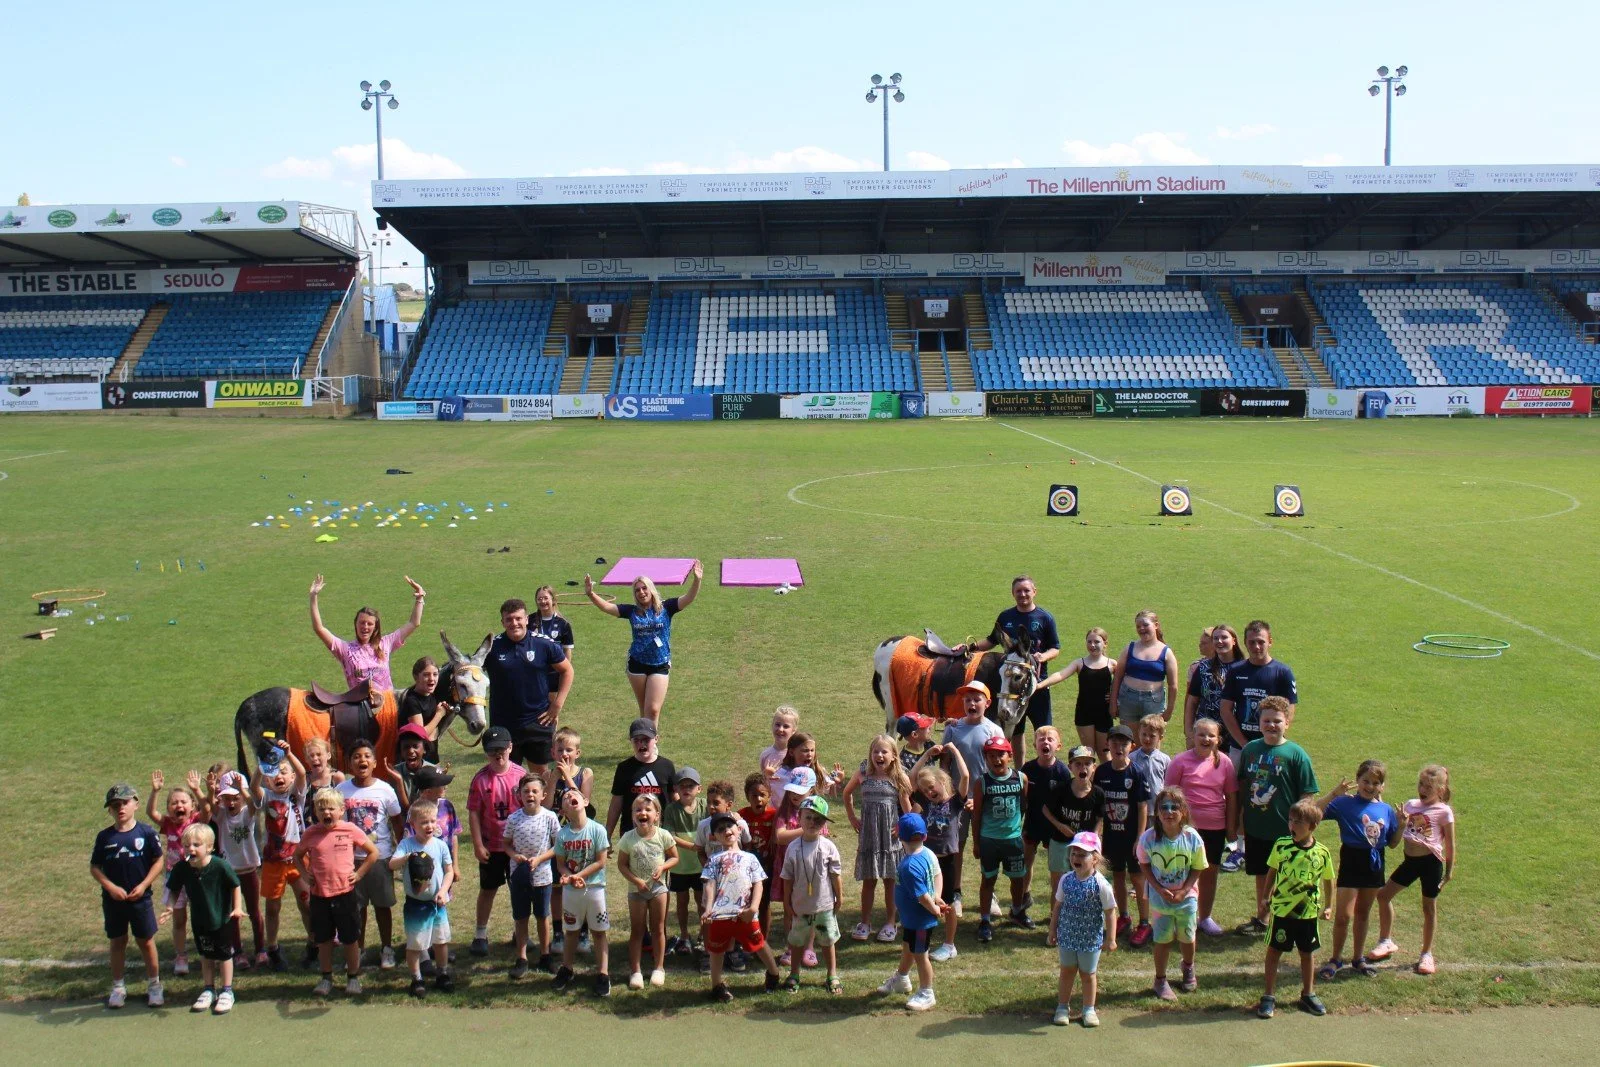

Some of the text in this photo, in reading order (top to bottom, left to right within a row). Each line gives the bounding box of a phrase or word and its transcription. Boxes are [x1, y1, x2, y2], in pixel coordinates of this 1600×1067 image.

[958, 178, 992, 194] Fulfilling
[1026, 176, 1225, 193] The Millennium Stadium
[674, 257, 725, 272] DJL
[767, 256, 818, 271] DJL
[860, 255, 911, 270] DJL
[953, 254, 1004, 269] DJL
[1186, 252, 1236, 267] DJL
[1277, 252, 1327, 266] DJL
[1368, 251, 1418, 266] DJL
[1460, 251, 1509, 266] DJL
[1551, 250, 1600, 265] DJL
[489, 261, 539, 276] DJL
[582, 259, 632, 274] DJL
[1033, 262, 1122, 277] Millennium
[8, 273, 137, 292] THE STABLE
[163, 273, 224, 288] SEDULO
[132, 391, 198, 400] CONSTRUCTION
[220, 382, 298, 396] ONWARD
[1503, 388, 1542, 400] ACTION
[510, 399, 532, 407] 01924
[992, 394, 1029, 404] Charles
[1050, 393, 1086, 403] Ashton
[1369, 399, 1384, 410] FEV
[1447, 396, 1469, 404] XTL
[441, 403, 455, 414] FEV
[631, 786, 662, 794] adidas
[987, 783, 1020, 794] CHICAGO
[564, 839, 592, 850] SPIDEY
